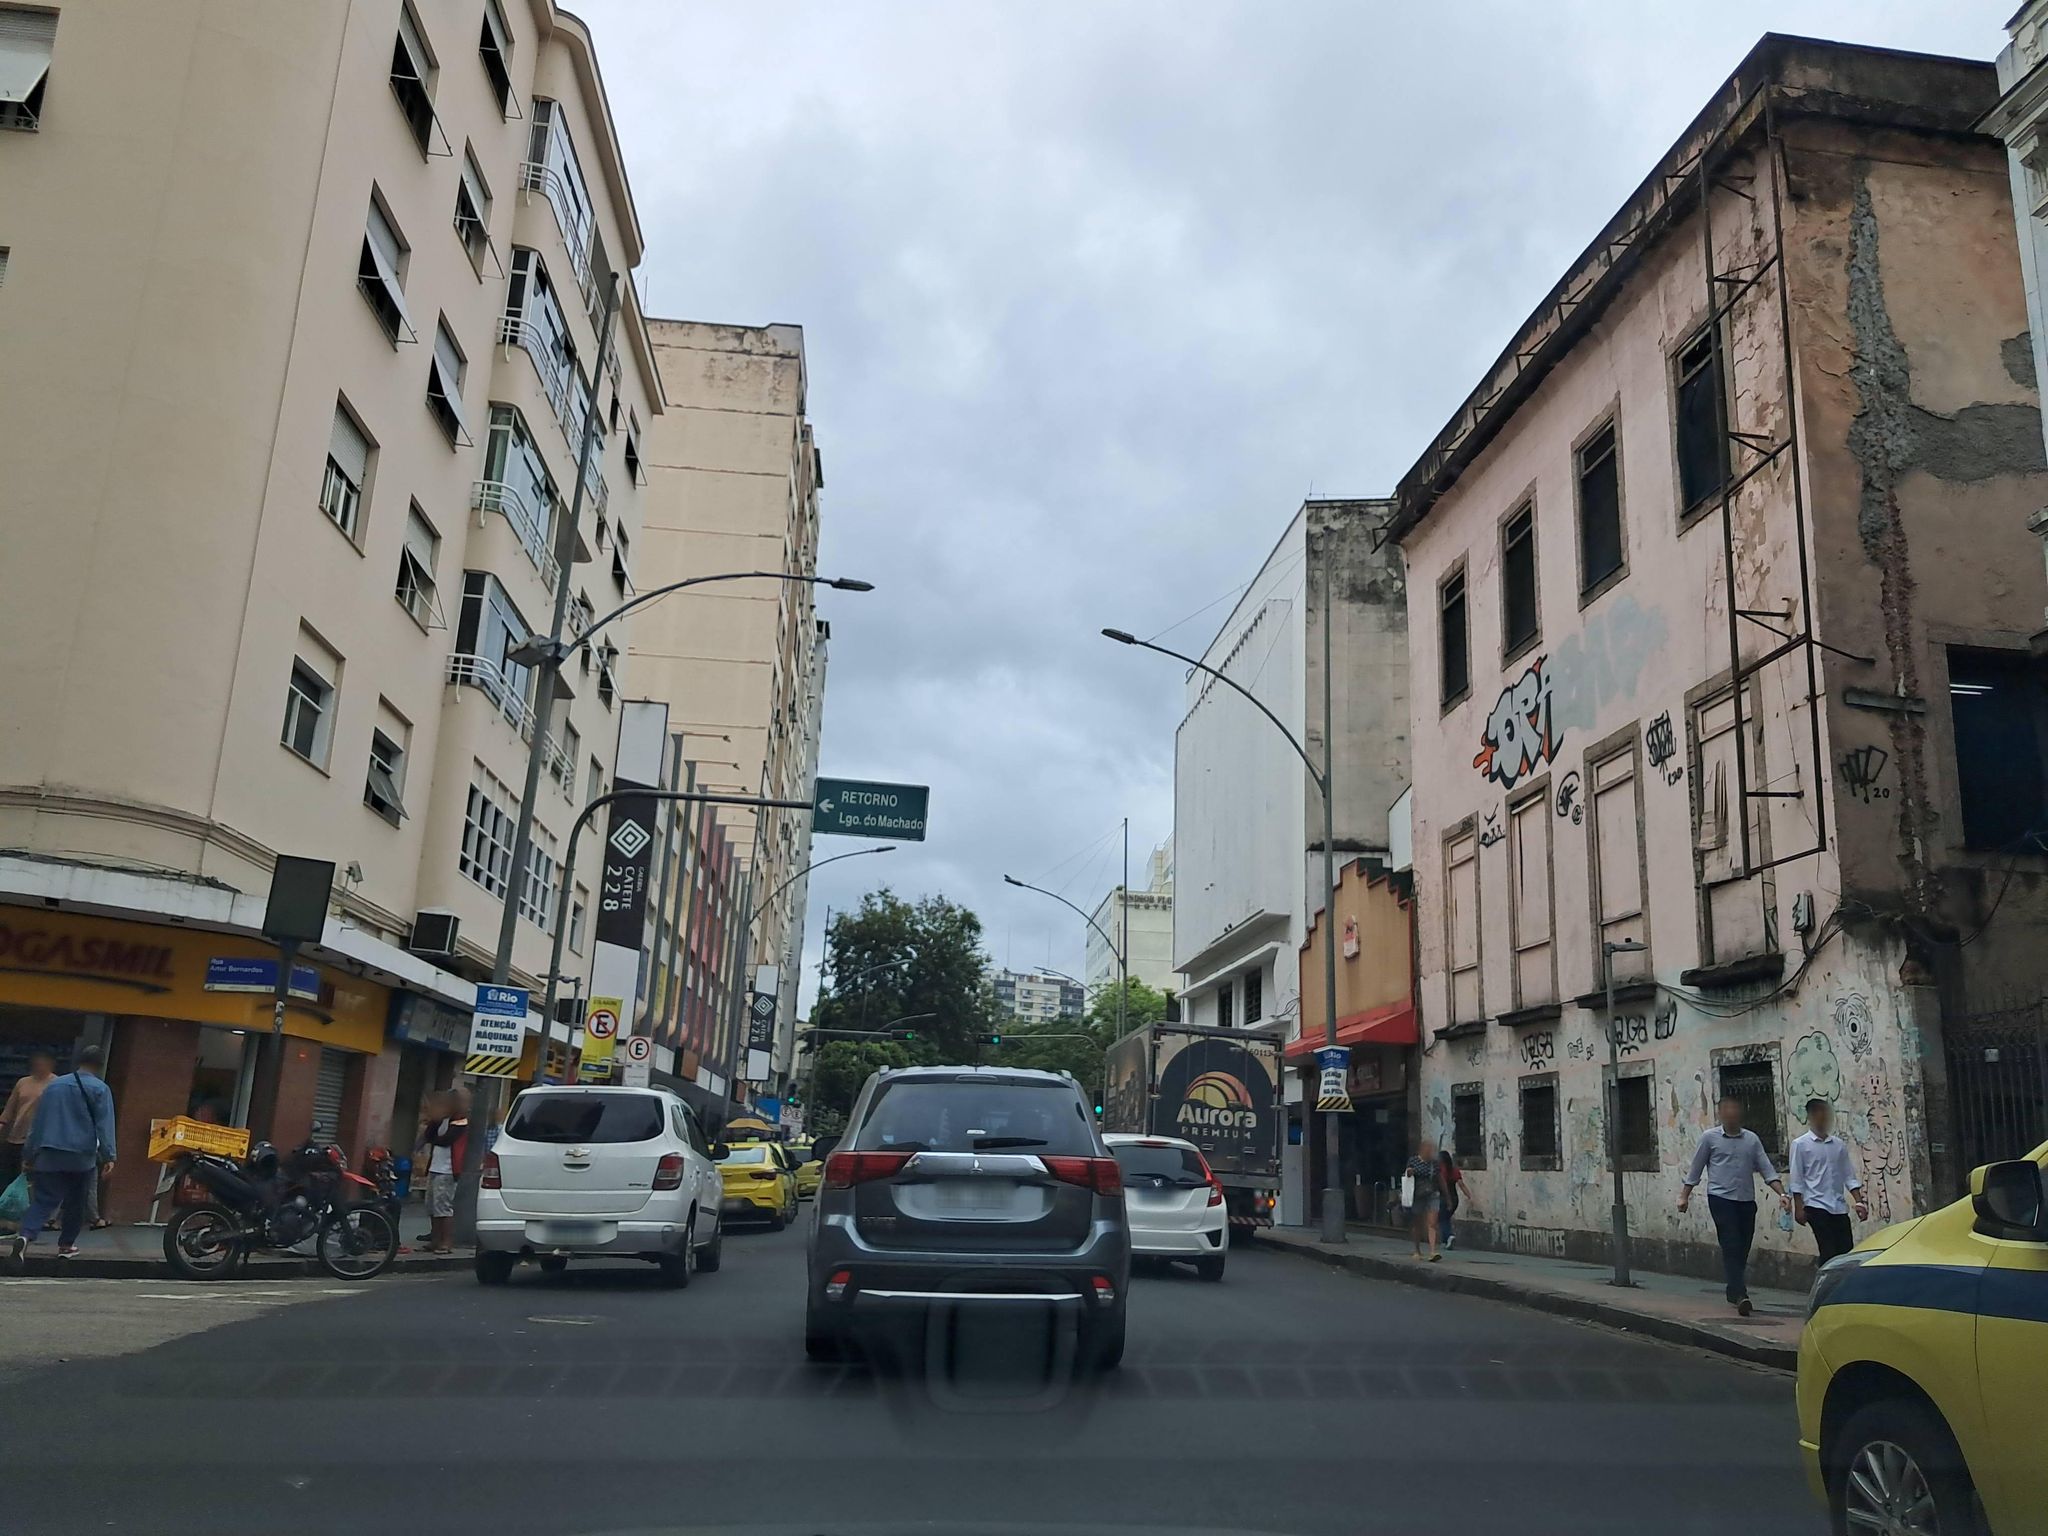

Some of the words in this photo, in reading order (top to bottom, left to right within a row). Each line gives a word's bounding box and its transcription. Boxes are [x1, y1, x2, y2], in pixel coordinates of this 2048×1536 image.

[841, 790, 898, 807] RETORNO
[839, 811, 861, 827] Lgo.
[863, 814, 876, 826] do
[877, 815, 924, 830] Machado
[621, 866, 635, 910] CATETE
[499, 991, 519, 1004] Rio
[480, 1018, 517, 1030] ATENÇÃO
[595, 1014, 610, 1034] E
[475, 1030, 519, 1042] MÁQUINAS
[476, 1043, 488, 1051] NA
[489, 1044, 513, 1054] PISTA
[635, 1042, 643, 1056] E
[1176, 1103, 1257, 1128] Aurora
[1181, 1125, 1251, 1140] PREMIUM
